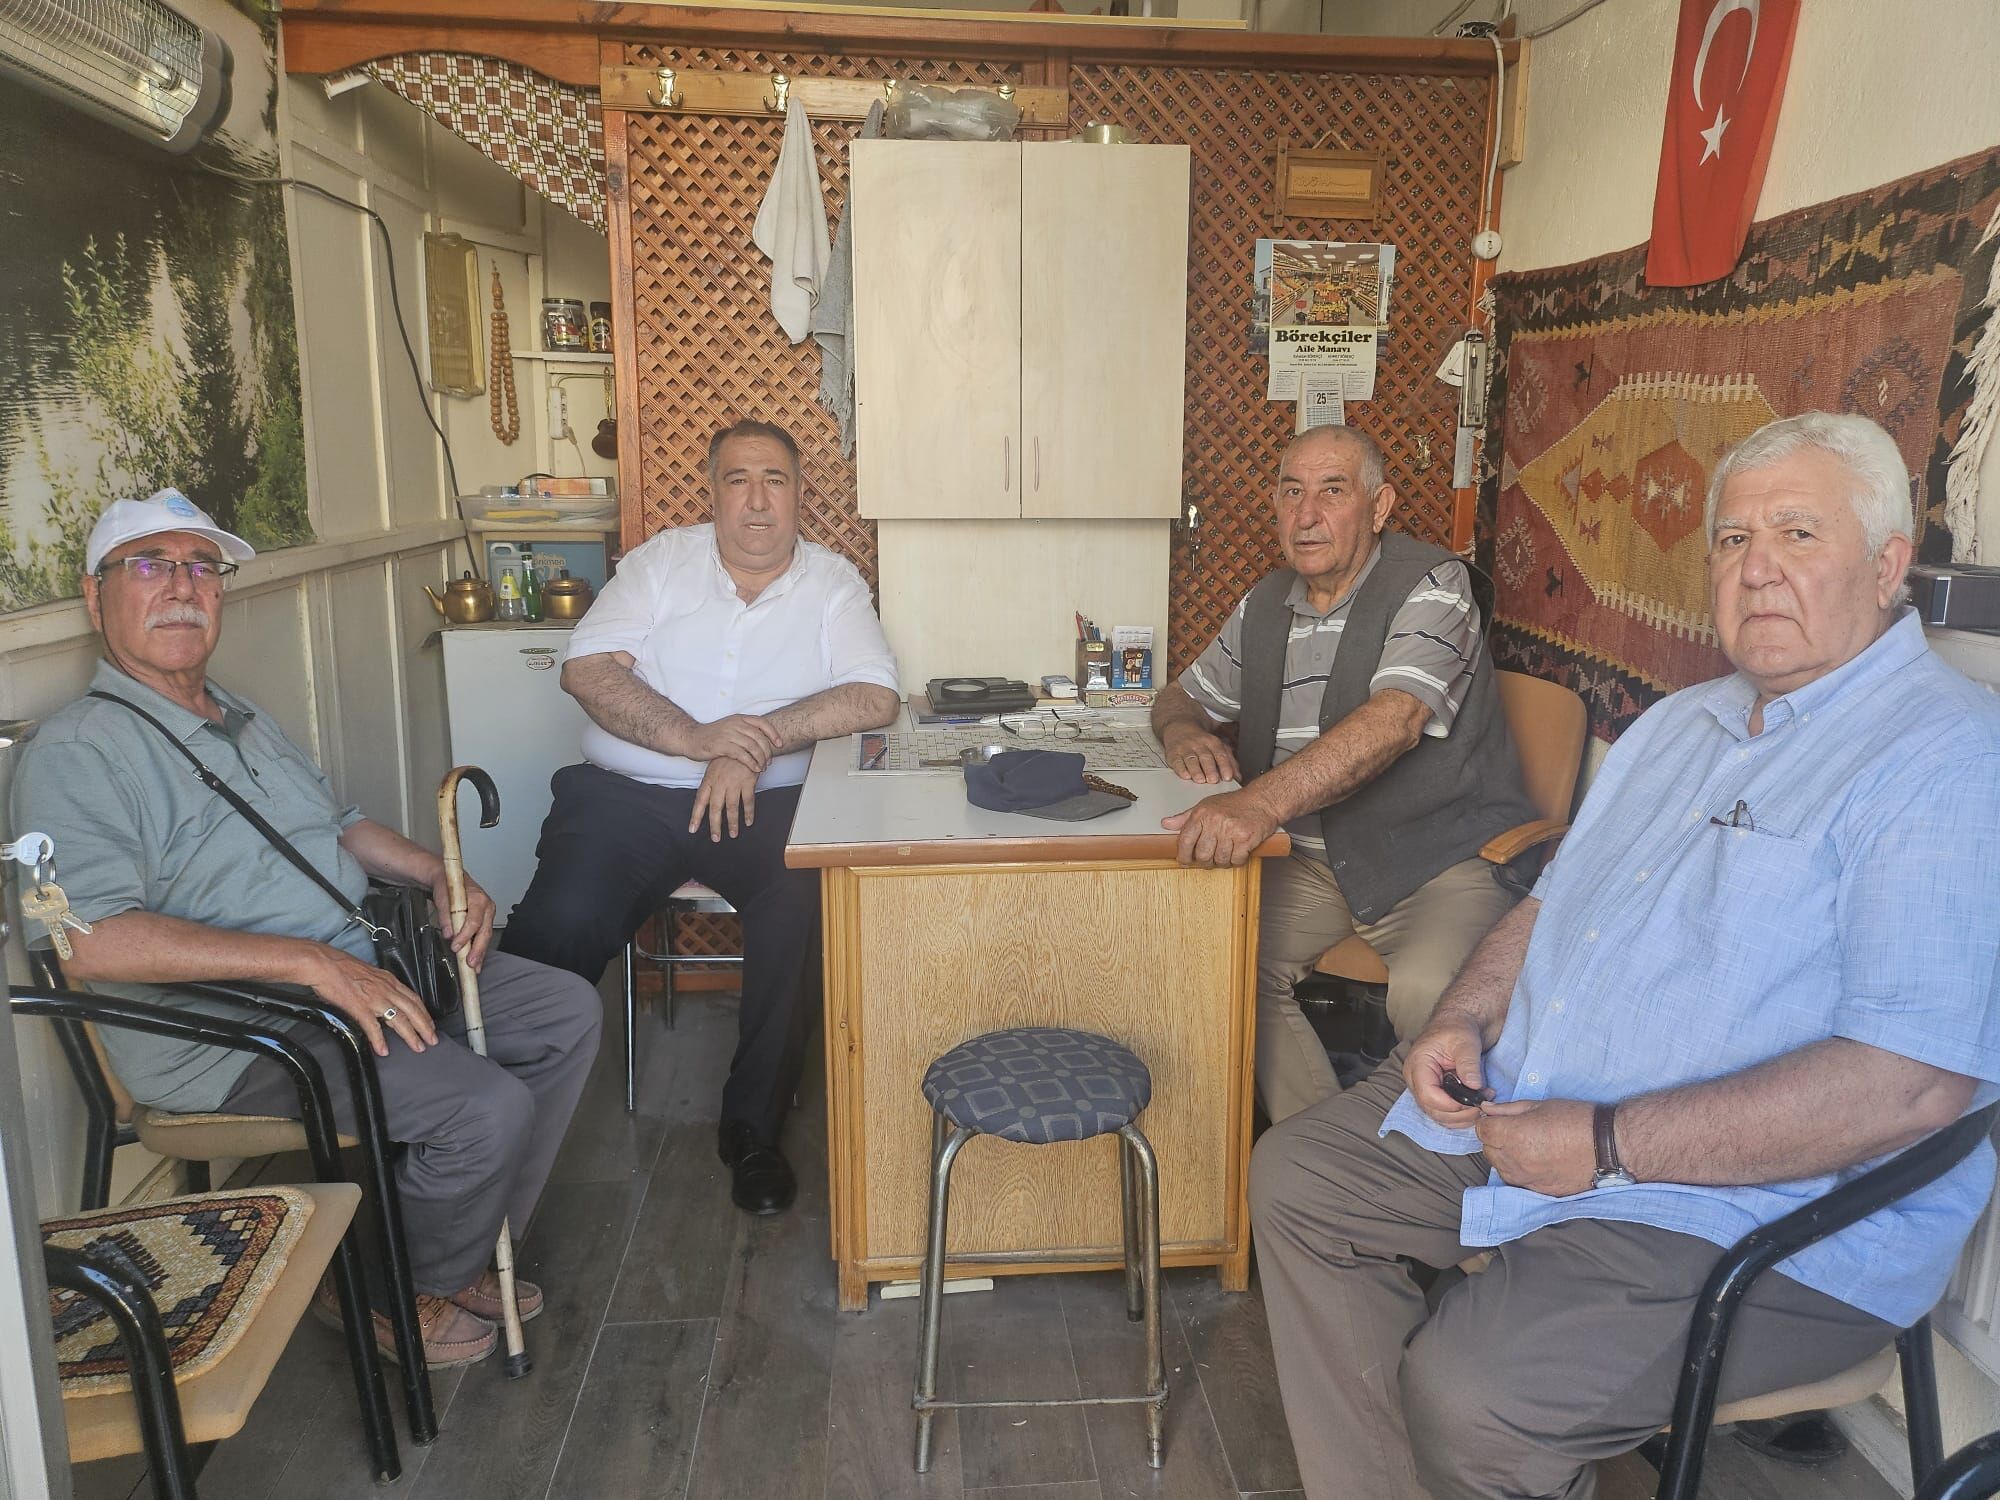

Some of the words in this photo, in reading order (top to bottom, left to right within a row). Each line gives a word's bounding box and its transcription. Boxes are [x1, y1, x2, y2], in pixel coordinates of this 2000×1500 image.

[1275, 329, 1373, 344] Börekçiler
[1295, 345, 1316, 353] Aile
[1317, 345, 1351, 353] Manavı
[1316, 392, 1327, 405] 25
